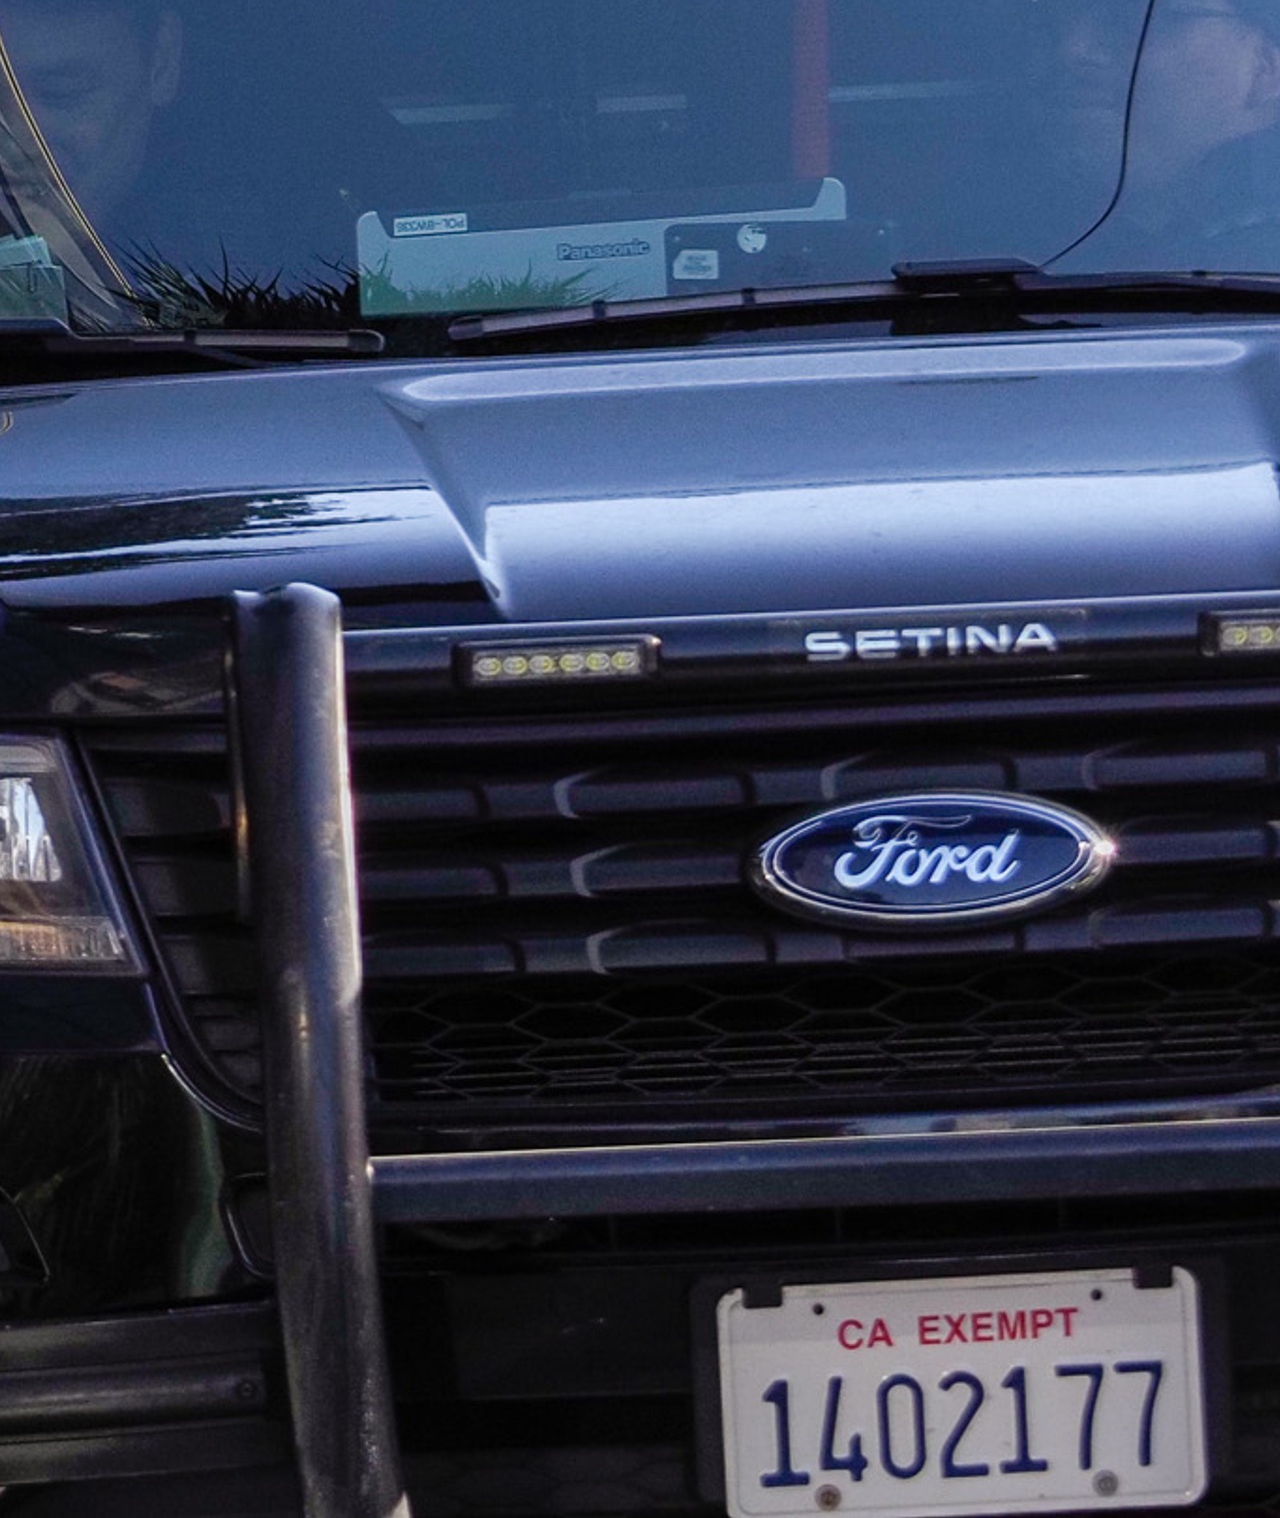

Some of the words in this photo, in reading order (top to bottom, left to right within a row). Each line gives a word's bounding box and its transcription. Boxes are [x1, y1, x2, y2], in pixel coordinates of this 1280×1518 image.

[556, 238, 650, 261] Panasonic
[804, 622, 1058, 661] SETINA
[834, 814, 1020, 889] Ford
[838, 1318, 893, 1350] CA
[918, 1307, 1079, 1346] EXEMPT
[760, 1360, 1163, 1488] 1402177
